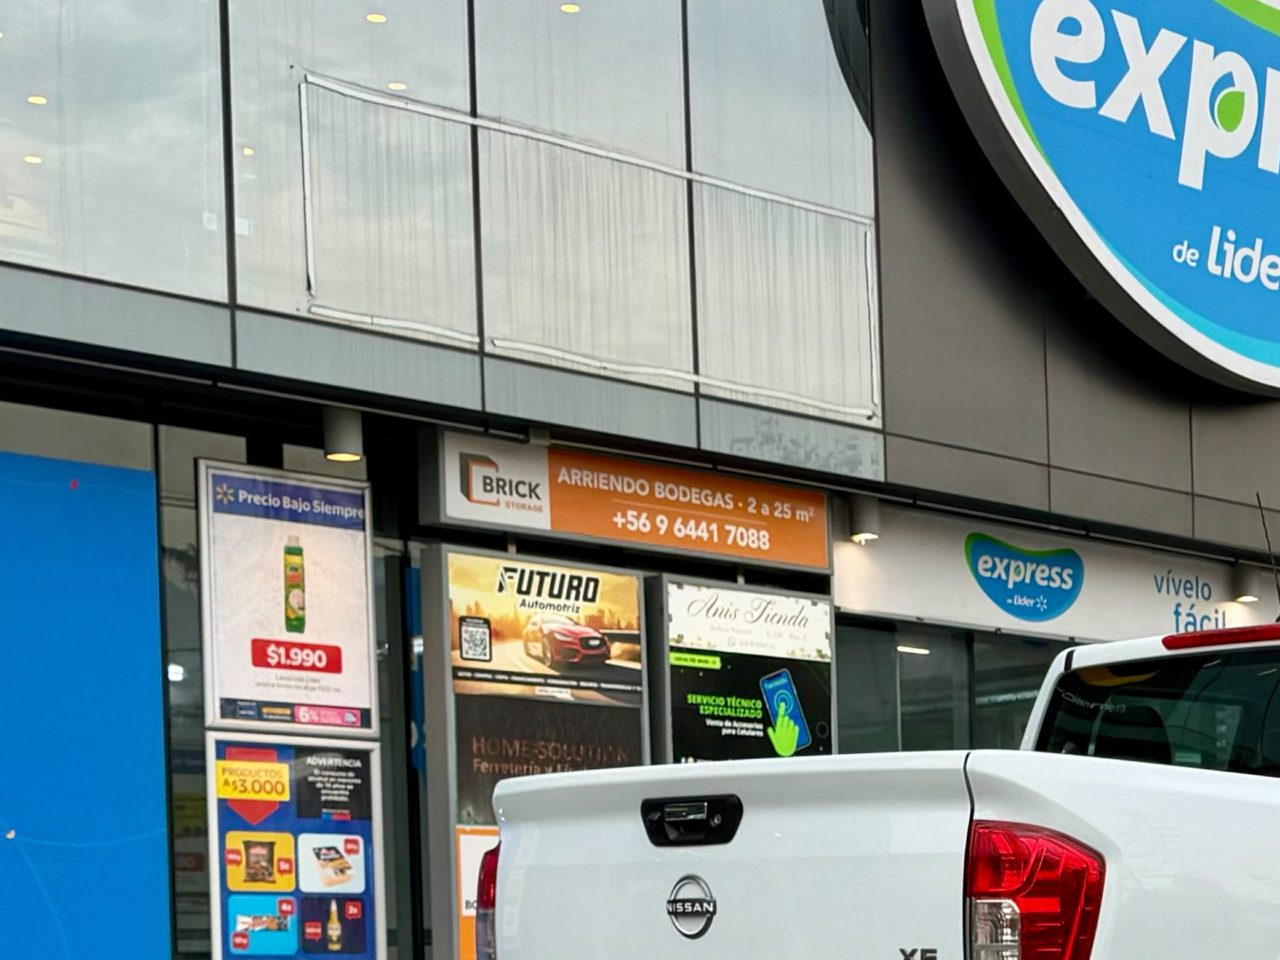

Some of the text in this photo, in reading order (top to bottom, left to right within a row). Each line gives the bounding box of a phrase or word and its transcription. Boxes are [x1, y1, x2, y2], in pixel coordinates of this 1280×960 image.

[1172, 240, 1199, 267] de
[482, 475, 541, 501] BRICK
[557, 467, 650, 496] ARRIENDO
[654, 482, 734, 510] BODEGAS
[747, 497, 757, 514] 2
[761, 503, 770, 516] a
[774, 502, 792, 519] 25
[238, 489, 364, 520] Precio Bajo Siempre
[505, 501, 543, 513] STORAGE
[612, 509, 770, 551] +56 9 6441 7088
[497, 566, 601, 604] FUTURO
[977, 554, 1073, 590] express
[1153, 568, 1212, 601] vívelo
[519, 598, 581, 614] Automotriz
[1173, 602, 1226, 633] fácil
[266, 643, 328, 669] $1.990
[686, 693, 763, 709] SERVICIO TÉCNICO
[699, 706, 763, 719] ESPECIALIZADO
[221, 767, 284, 778] PRODUCTOS
[306, 756, 362, 768] ADVERTENCIA
[473, 758, 541, 776] Ferretería
[667, 902, 714, 912] NISSAN
